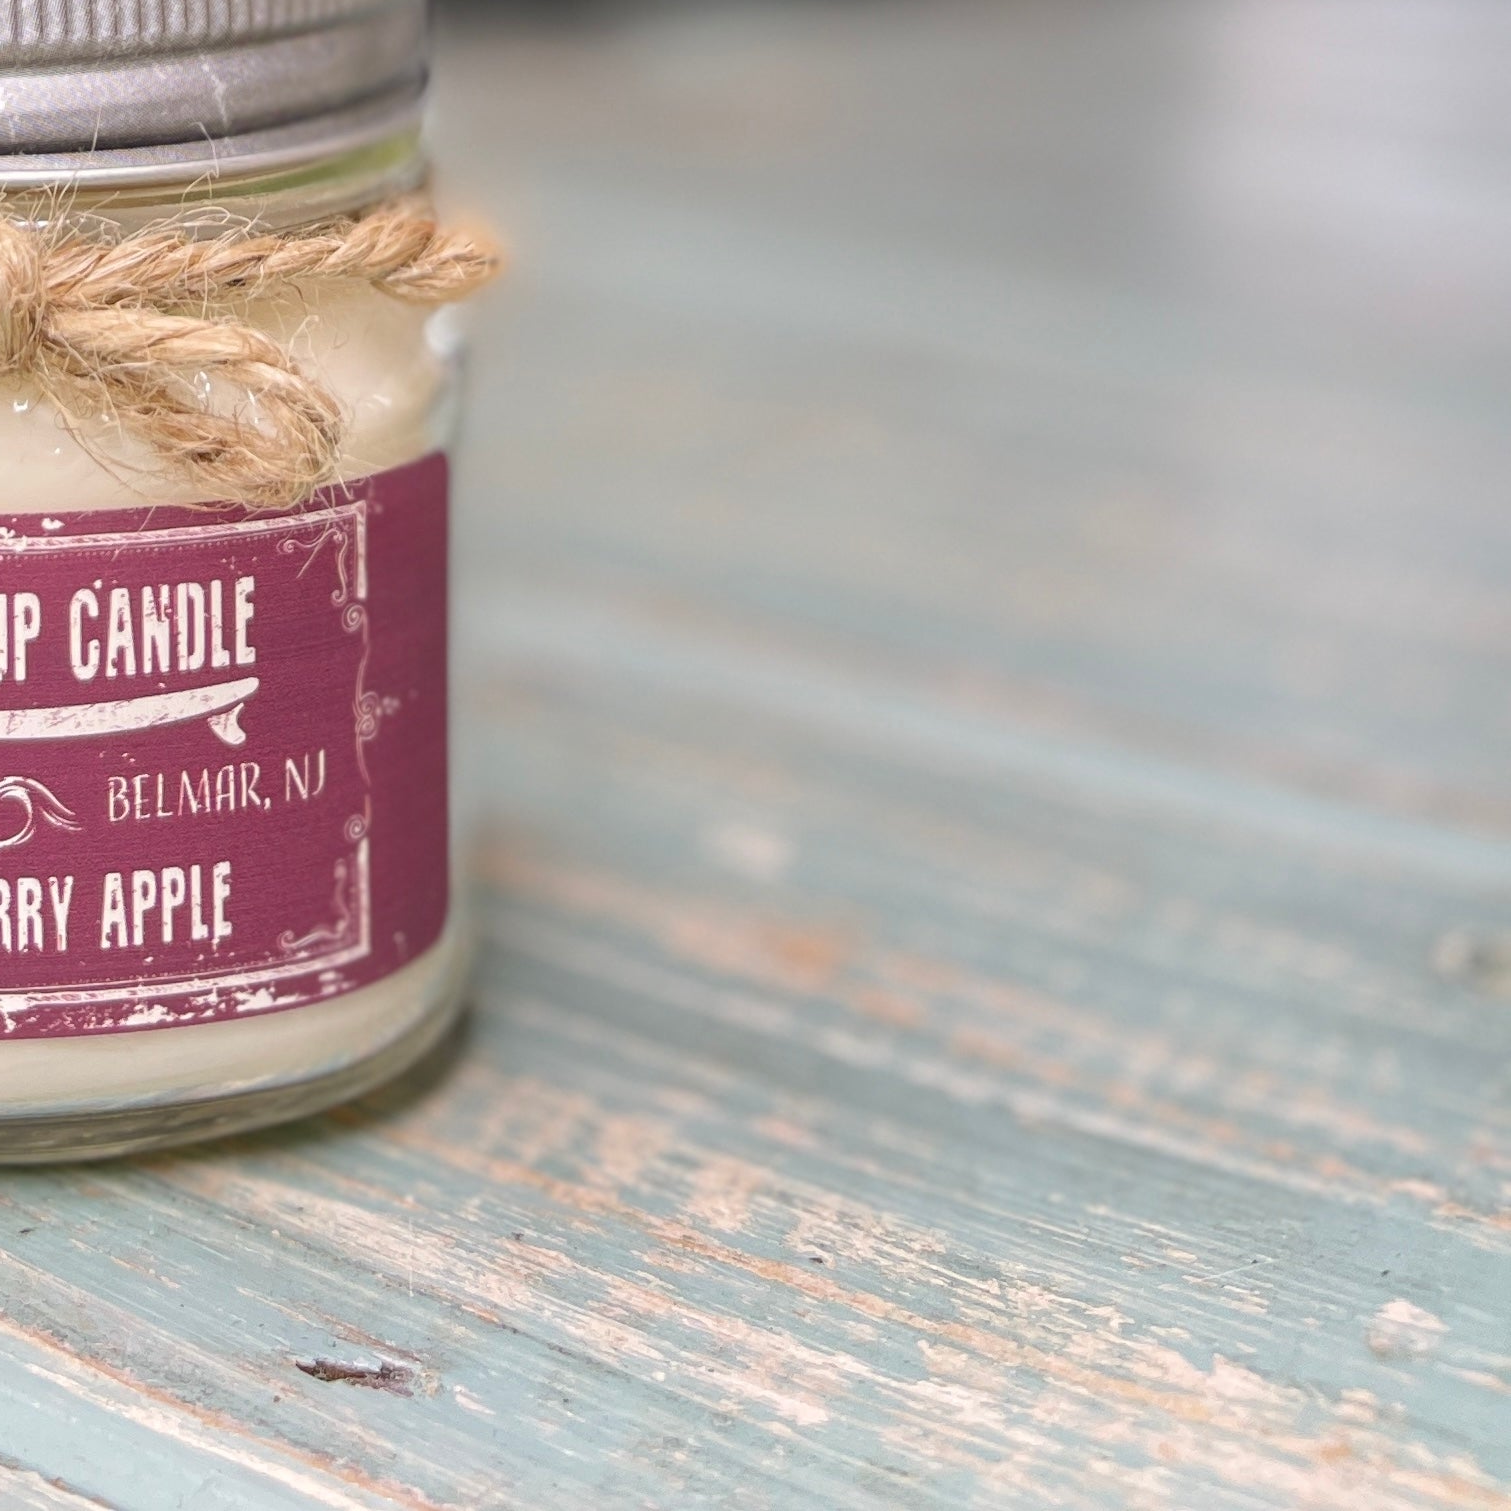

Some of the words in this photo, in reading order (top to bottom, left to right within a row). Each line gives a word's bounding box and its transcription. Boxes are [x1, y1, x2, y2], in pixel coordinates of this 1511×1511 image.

[69, 576, 257, 681] CANDLE
[107, 761, 271, 822] BELMAR,
[285, 749, 325, 801] NJ
[99, 860, 233, 950] APPLE
